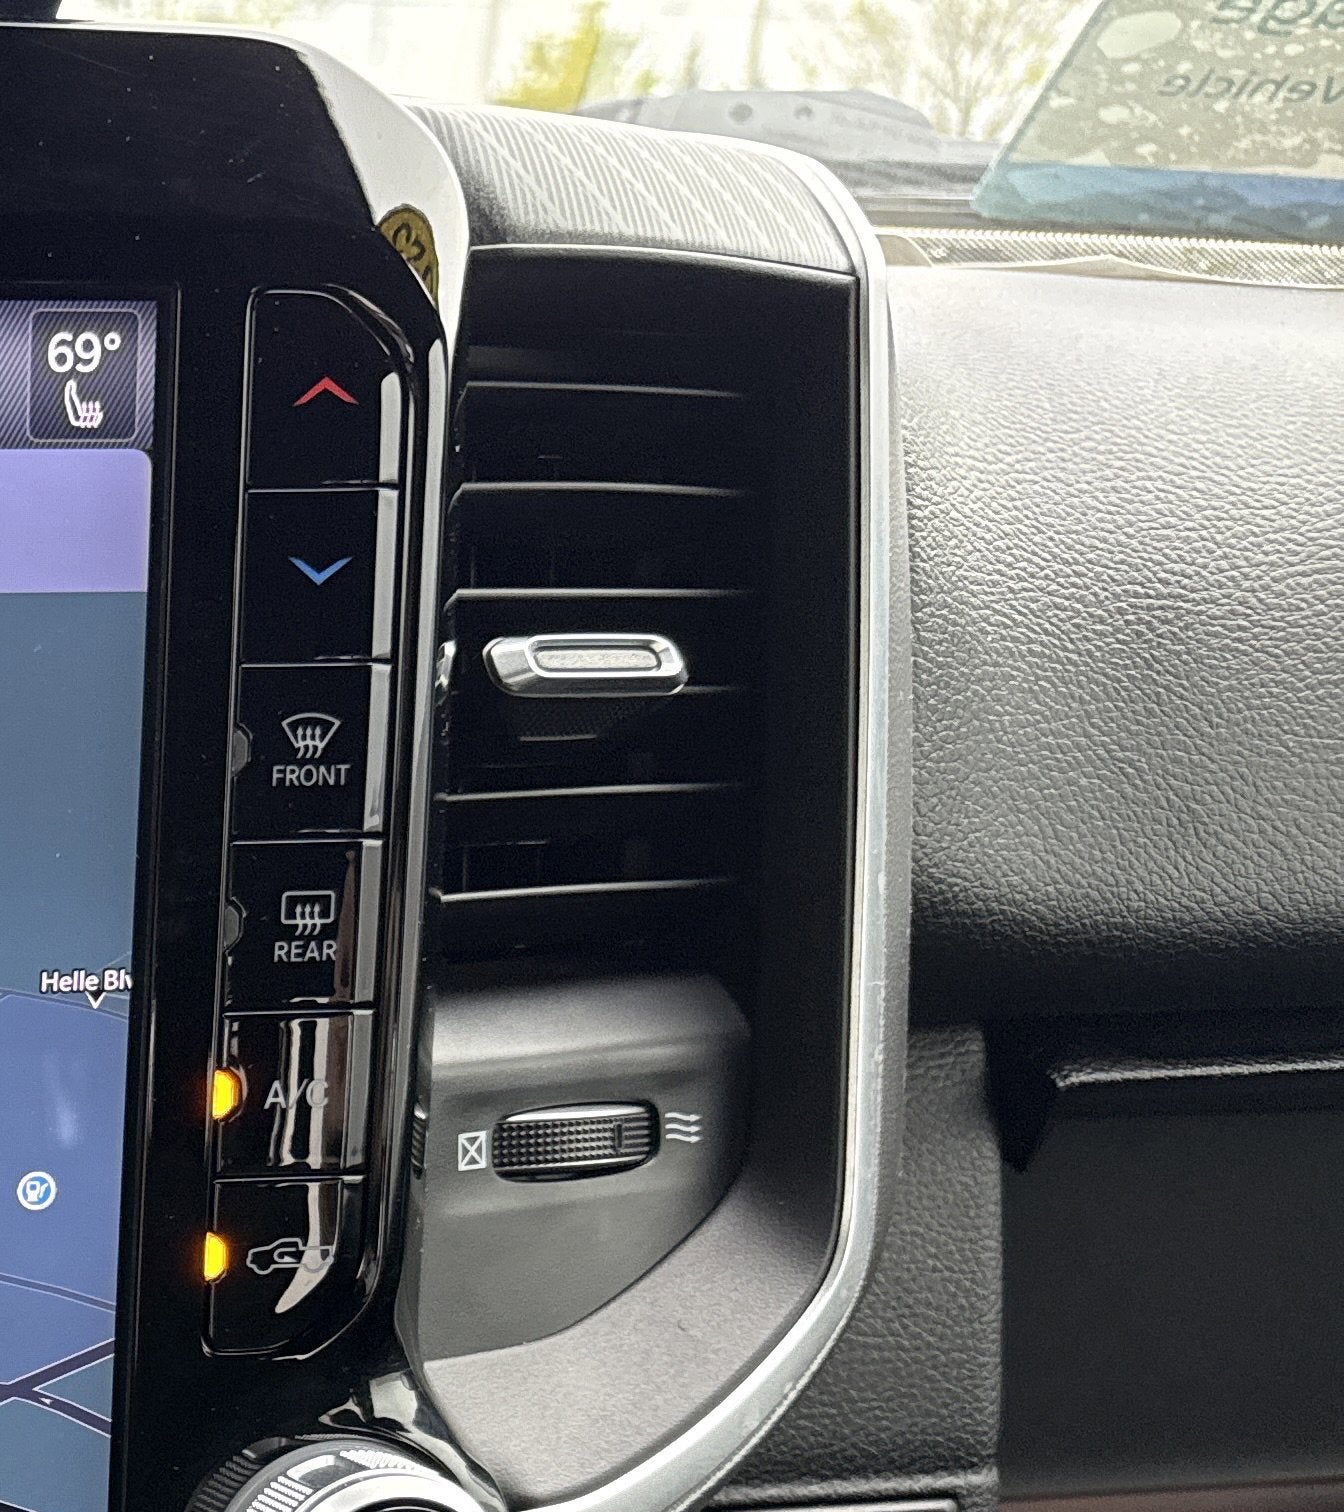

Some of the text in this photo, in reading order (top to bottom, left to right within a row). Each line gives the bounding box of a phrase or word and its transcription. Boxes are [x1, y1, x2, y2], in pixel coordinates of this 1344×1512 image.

[46, 331, 121, 373] 69°
[271, 764, 351, 787] FRONT
[273, 941, 337, 962] REAR
[40, 970, 99, 993] Helle
[264, 1078, 329, 1109] A/C
